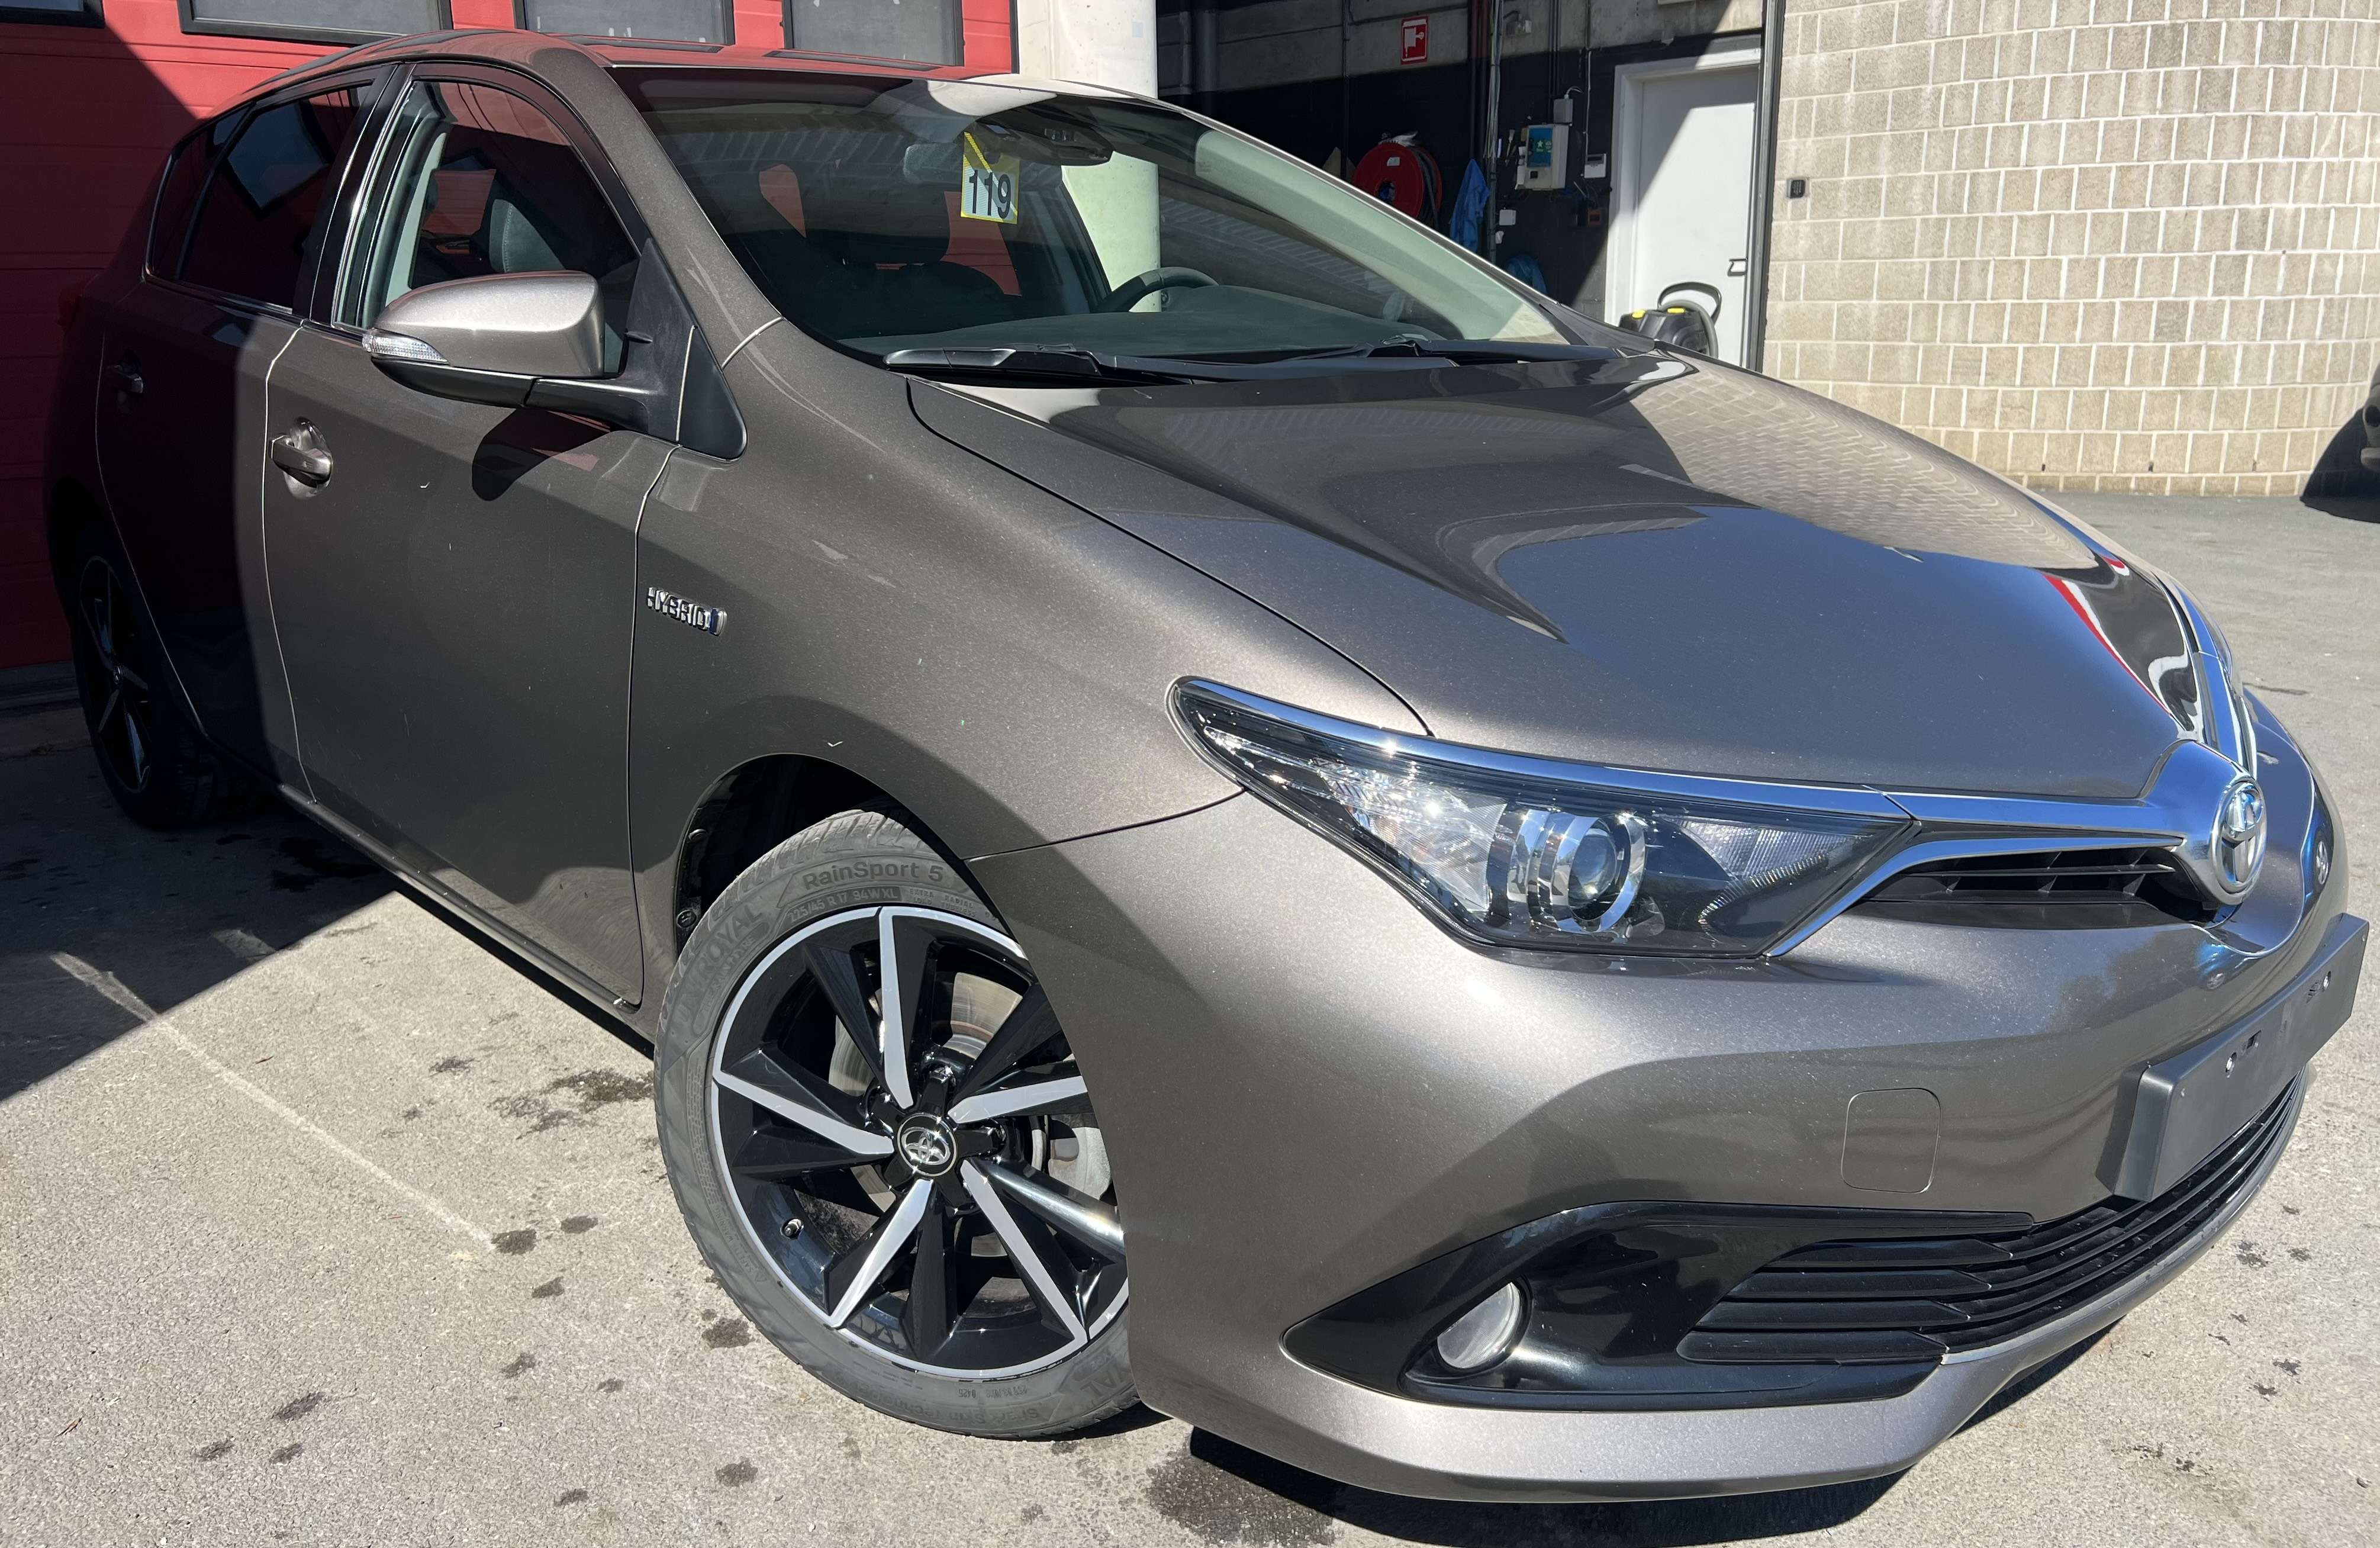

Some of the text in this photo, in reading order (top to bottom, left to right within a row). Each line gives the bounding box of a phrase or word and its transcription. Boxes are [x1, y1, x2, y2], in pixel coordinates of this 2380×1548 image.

[969, 169, 1012, 219] 119
[647, 587, 711, 631] HYBRID
[802, 859, 943, 890] RainSport 5
[789, 902, 826, 923] 225/45
[944, 895, 974, 909] RADIAL
